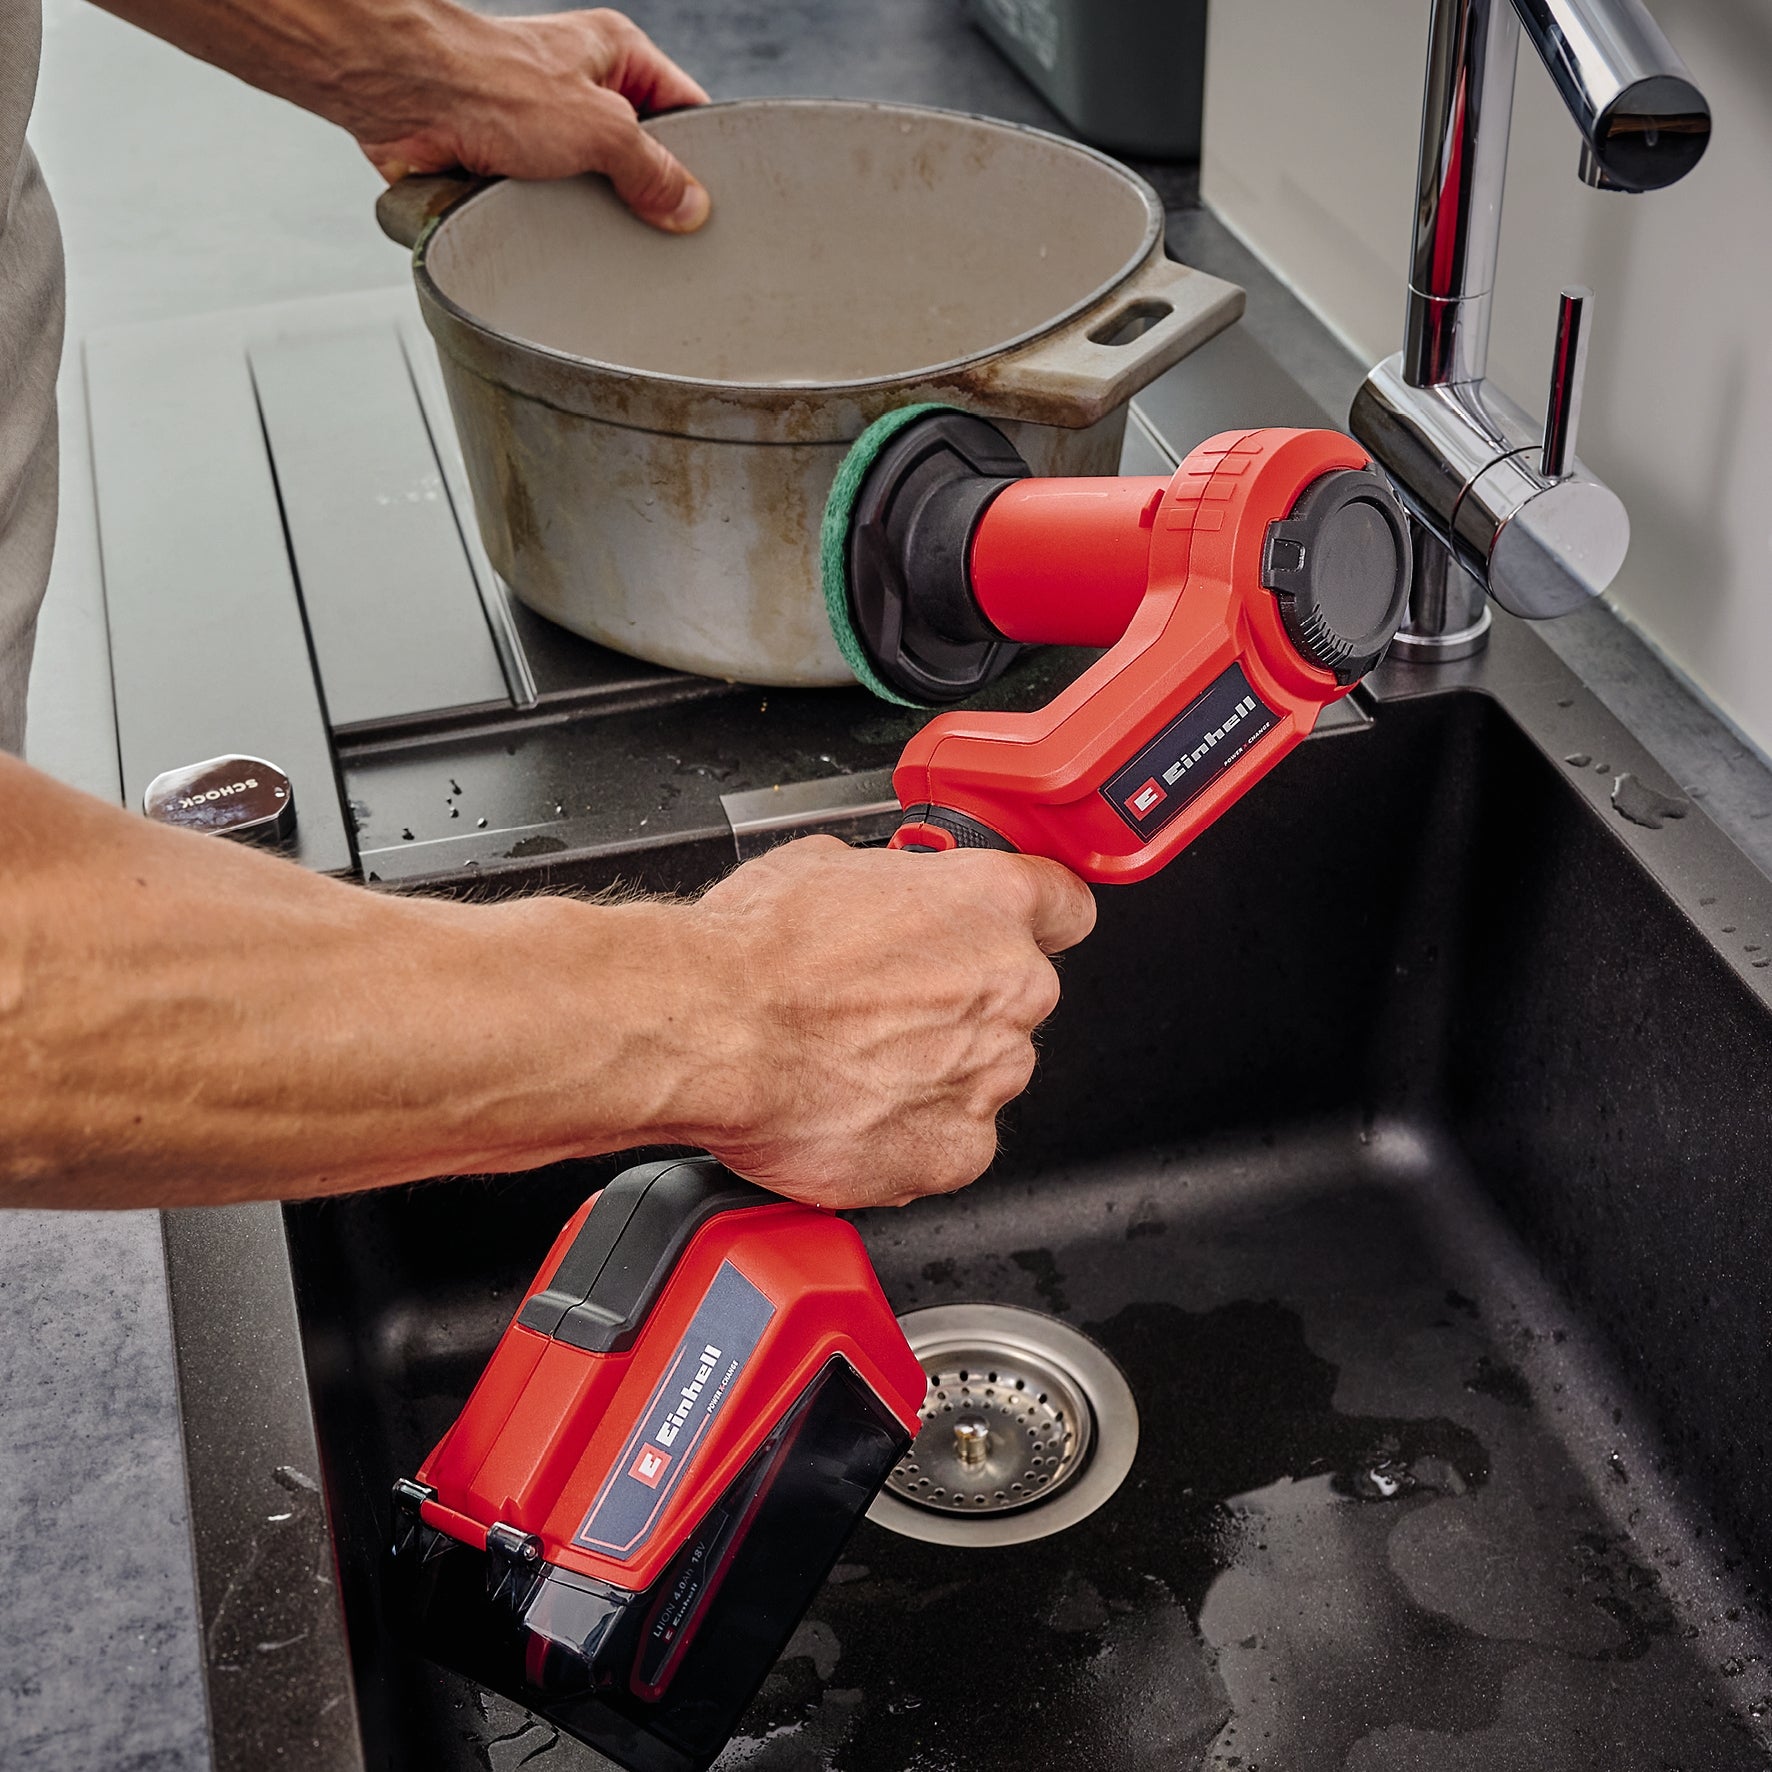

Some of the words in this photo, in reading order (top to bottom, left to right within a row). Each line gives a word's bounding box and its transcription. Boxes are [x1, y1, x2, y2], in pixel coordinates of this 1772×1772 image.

[1162, 695, 1256, 786] Einhell
[1223, 747, 1243, 767] POWER
[178, 779, 259, 809] SCHOCK
[655, 1344, 722, 1447] Einhell
[706, 1389, 723, 1413] POWER
[691, 1541, 706, 1563] 18V
